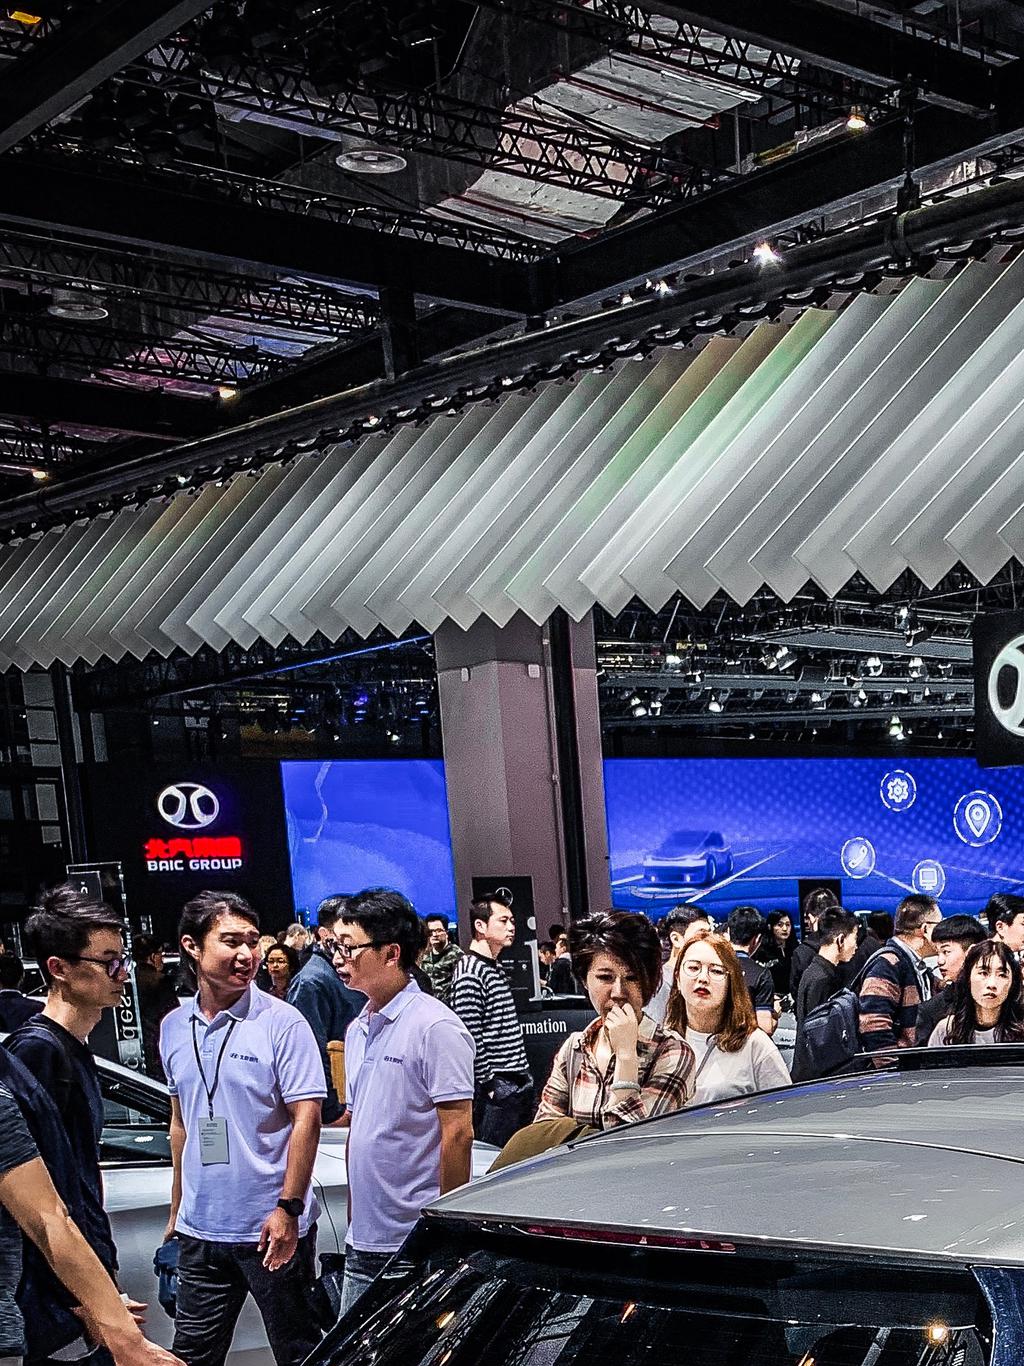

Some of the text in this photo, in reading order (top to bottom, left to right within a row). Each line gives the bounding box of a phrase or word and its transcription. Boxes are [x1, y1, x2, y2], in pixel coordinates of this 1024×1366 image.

[147, 858, 242, 871] BAIC GROUP
[519, 1019, 567, 1035] rmation
